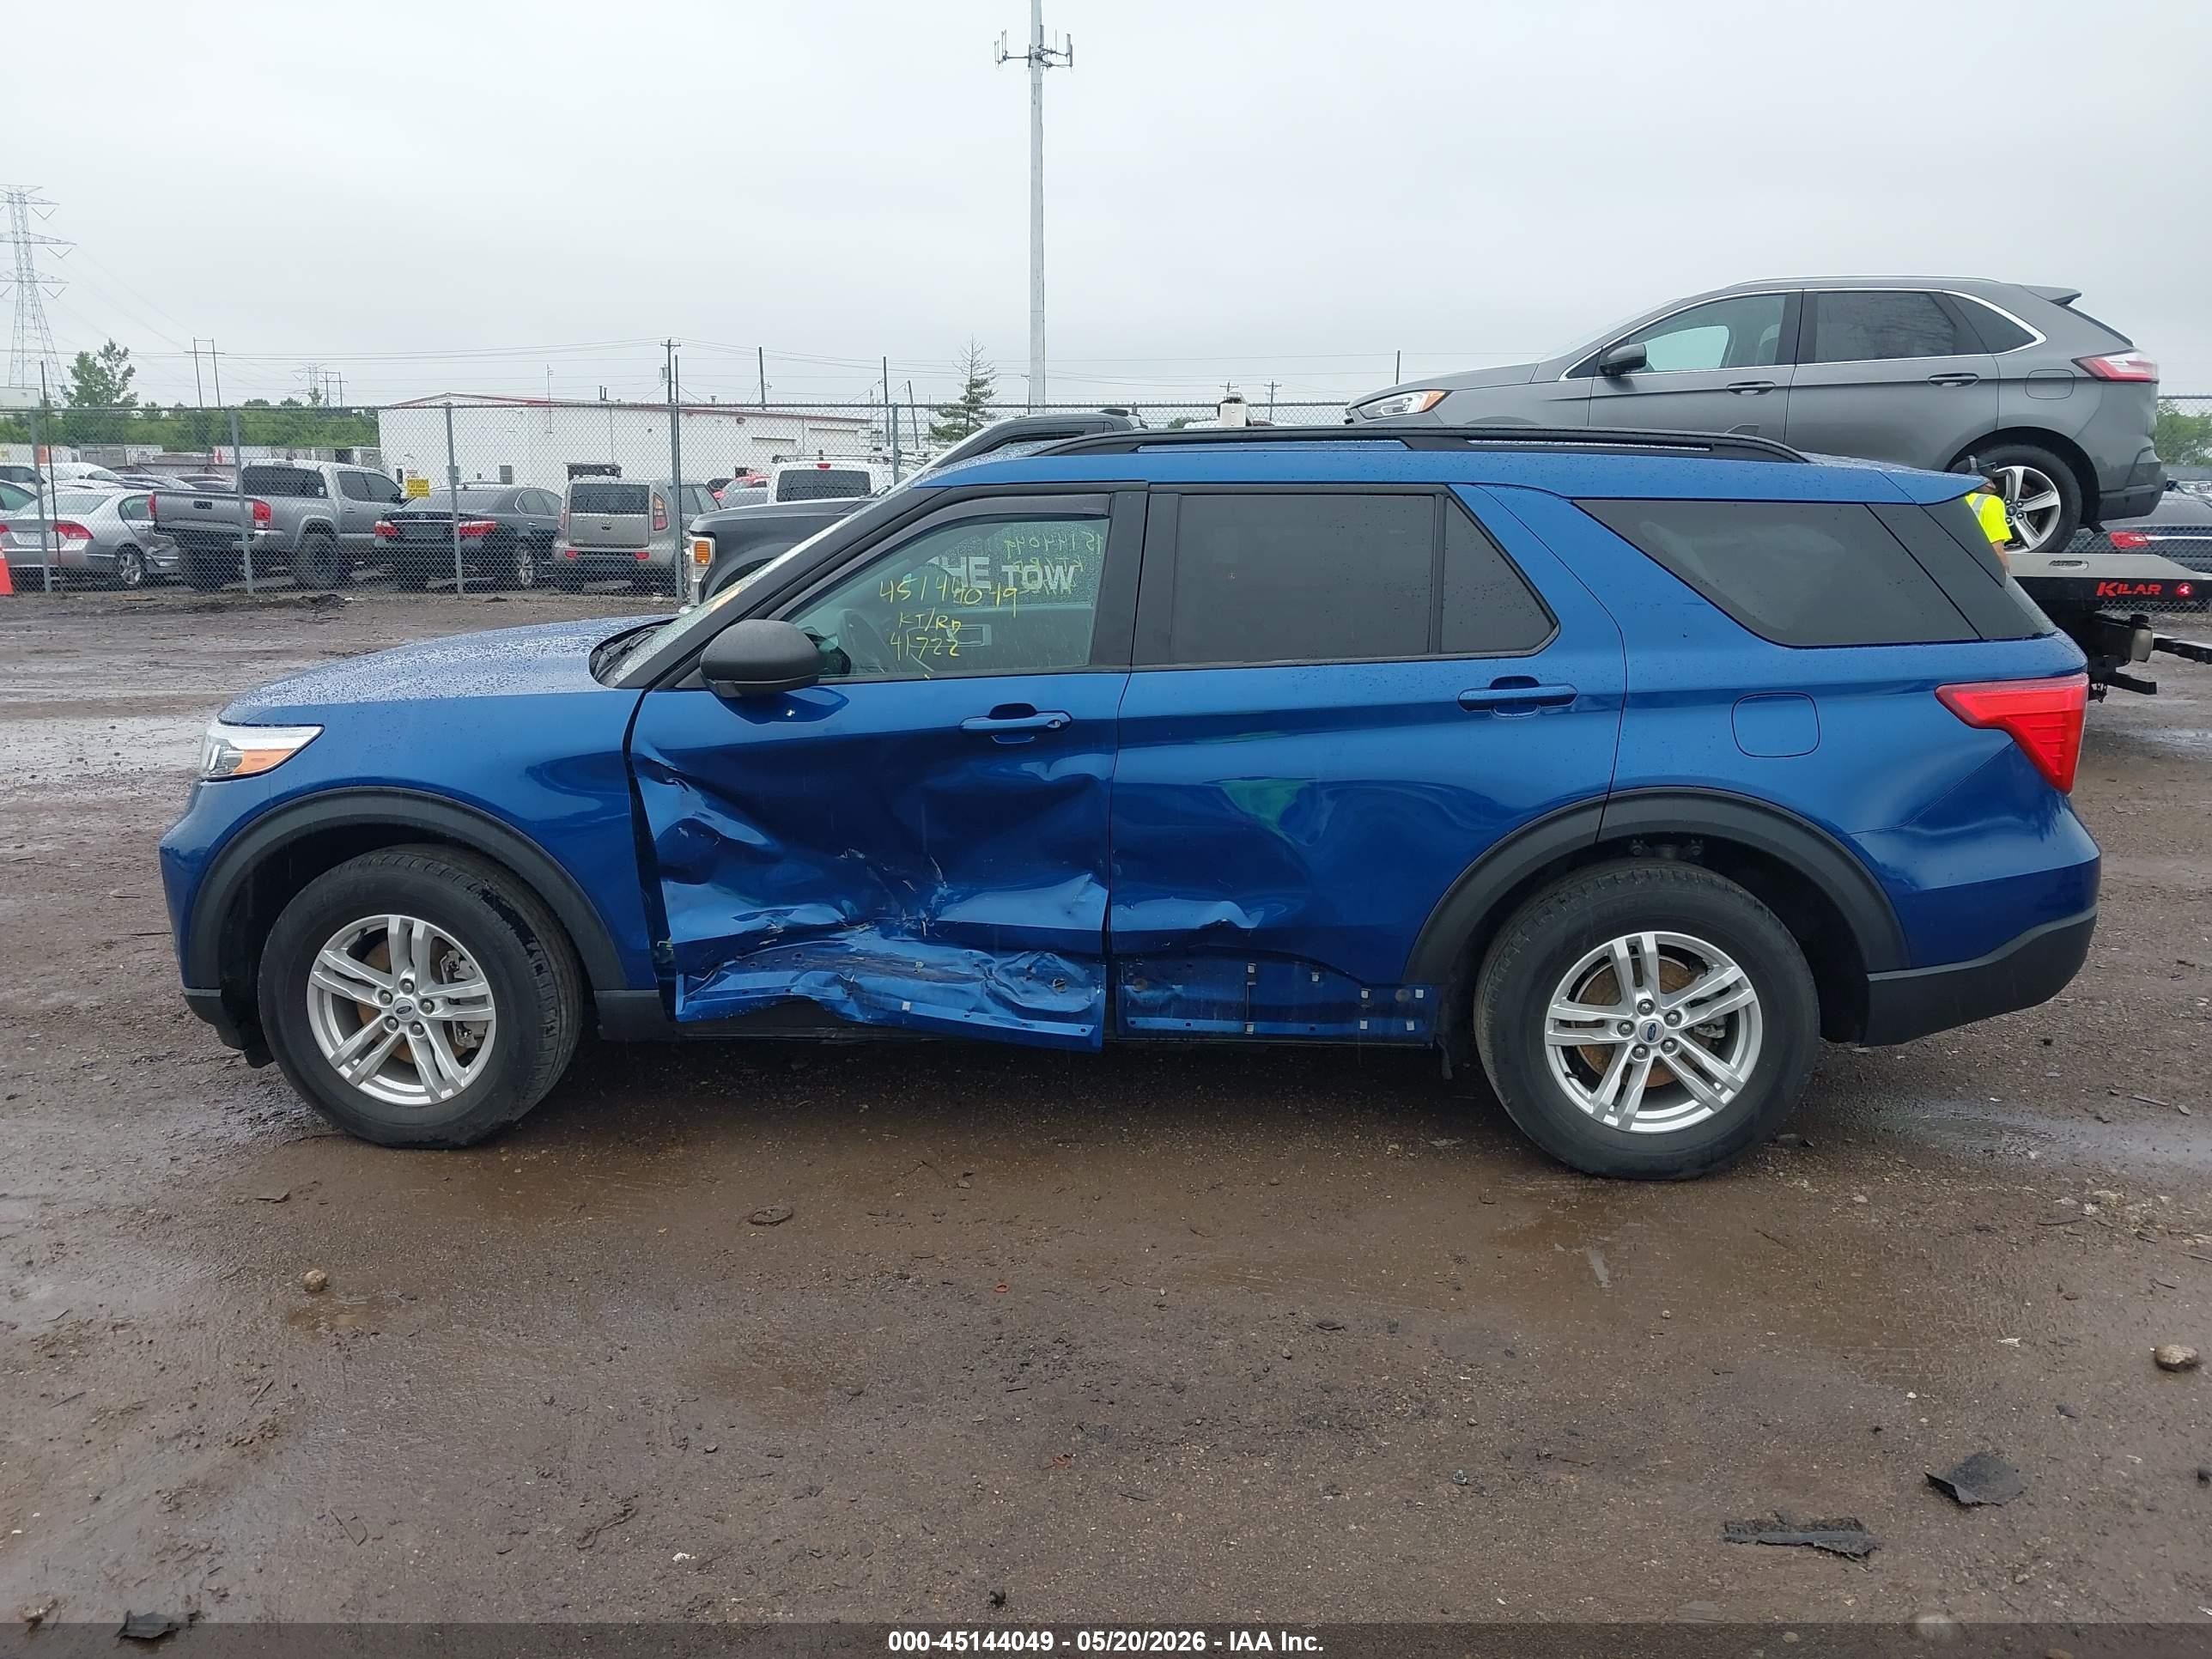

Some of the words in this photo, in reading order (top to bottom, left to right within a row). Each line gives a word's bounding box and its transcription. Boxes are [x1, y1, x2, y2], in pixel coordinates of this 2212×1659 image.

[1001, 565, 1075, 590] TOW
[2096, 581, 2162, 597] KILAR
[890, 632, 960, 661] 41722
